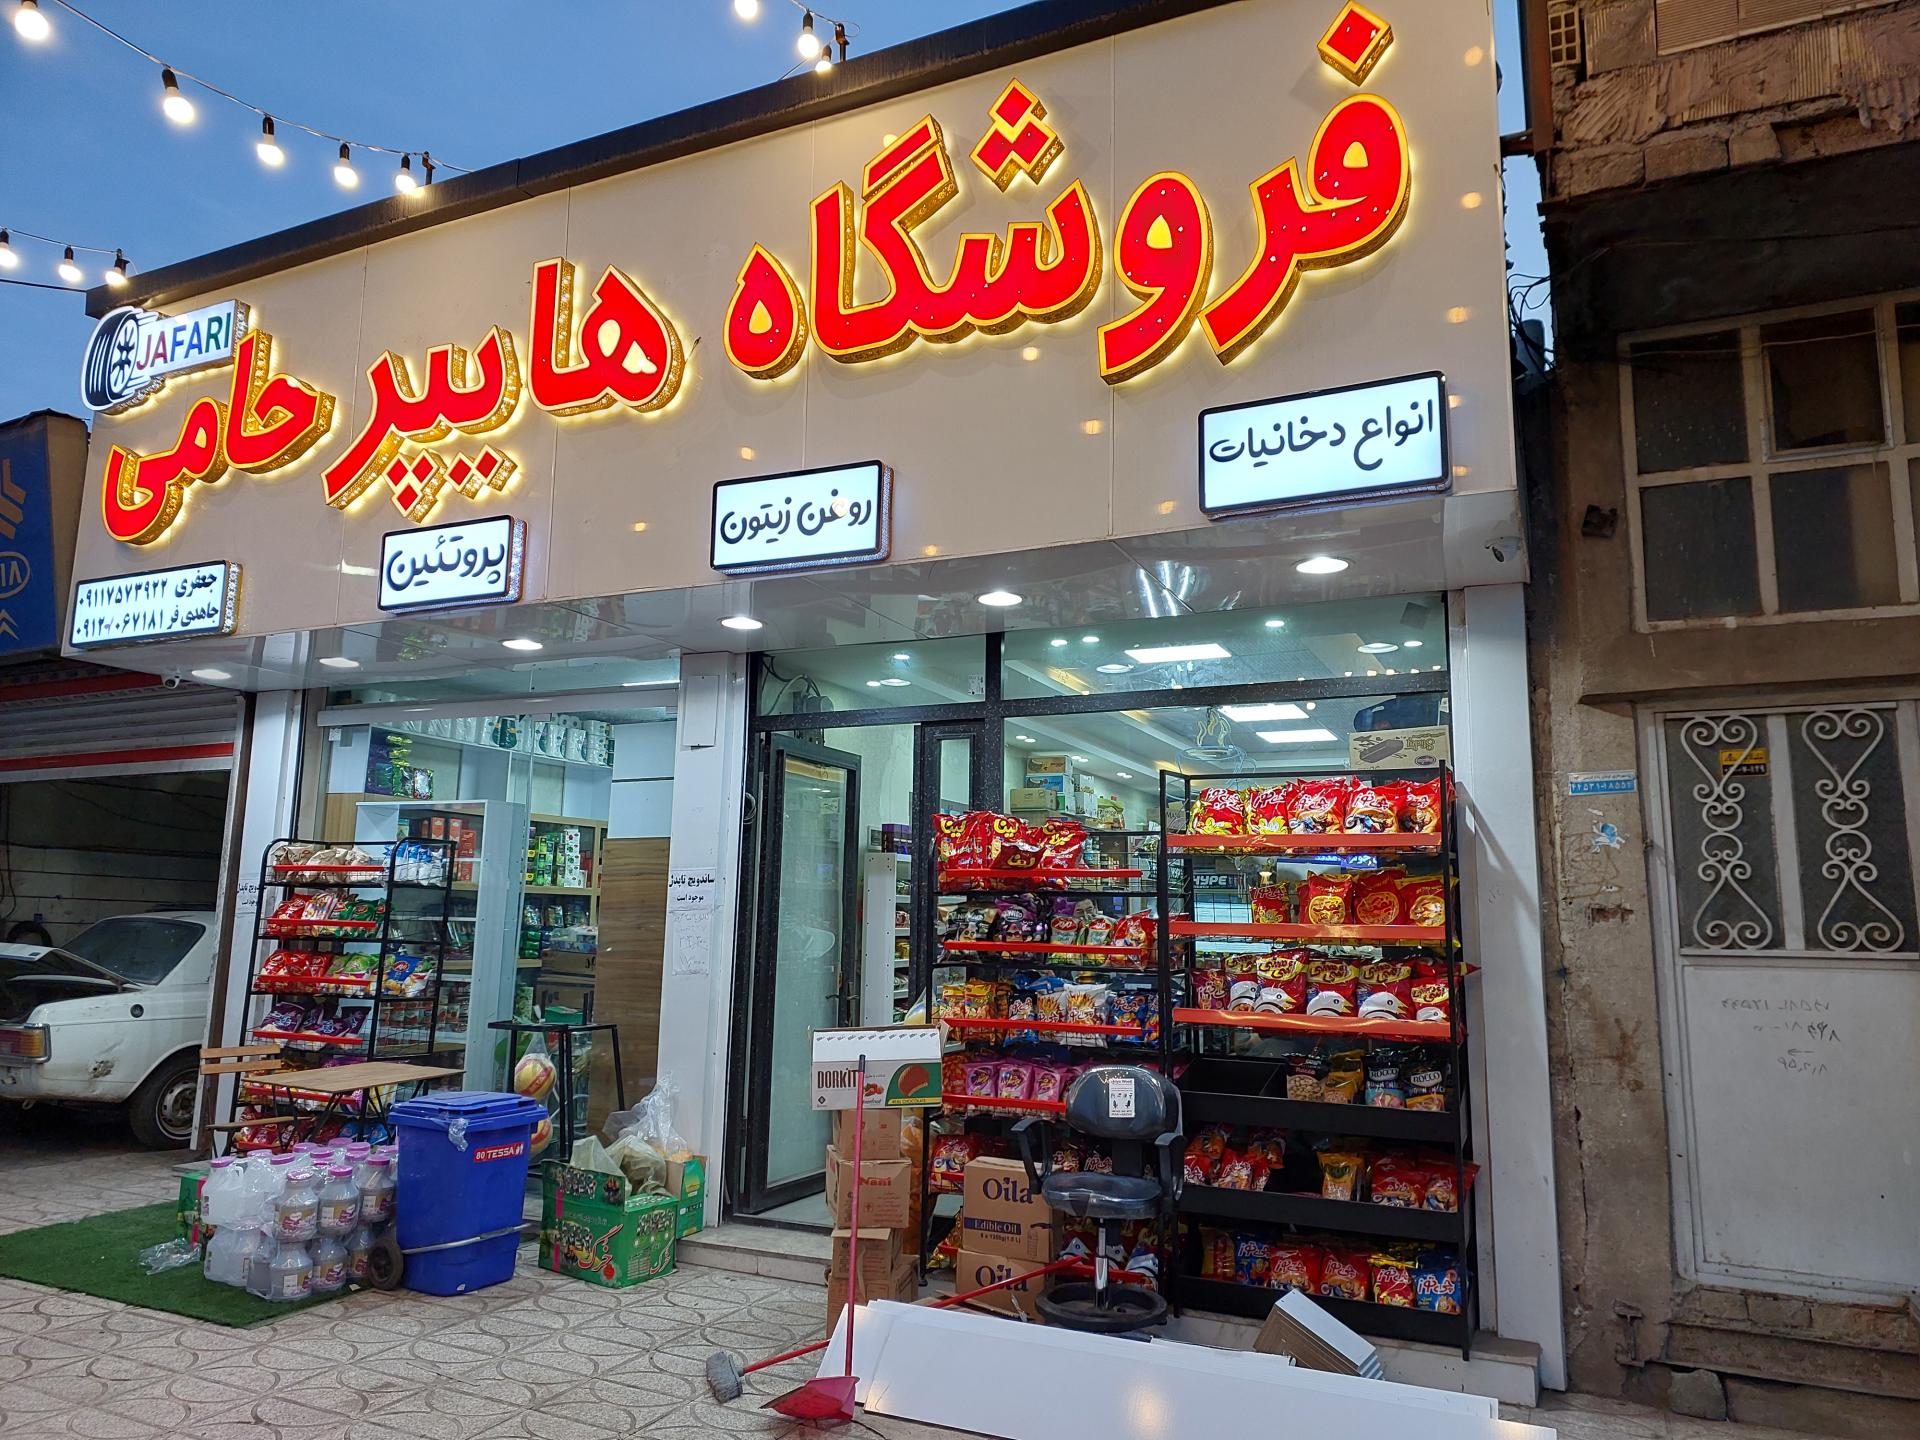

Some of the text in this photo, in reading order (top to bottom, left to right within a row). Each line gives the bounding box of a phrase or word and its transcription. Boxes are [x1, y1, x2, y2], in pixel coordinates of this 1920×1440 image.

[102, 1, 1411, 546] فروشگاه هایپر حامی
[136, 311, 232, 370] JAFARI
[1209, 399, 1433, 471] انواع دخانیات
[720, 489, 871, 545] روغن زیتون
[0, 560, 22, 587] IA
[386, 536, 505, 592] پروتئین
[79, 569, 217, 608] جعفری ۰۹۱۱۷۵۷۳۹۲۲
[677, 894, 704, 904] موجود است
[1371, 1068, 1398, 1078] ROCCO
[1413, 1072, 1440, 1083] ROCCO
[486, 1146, 514, 1159] TESSA
[982, 1177, 1034, 1204] Oila
[974, 1219, 1017, 1234] Edible Oil
